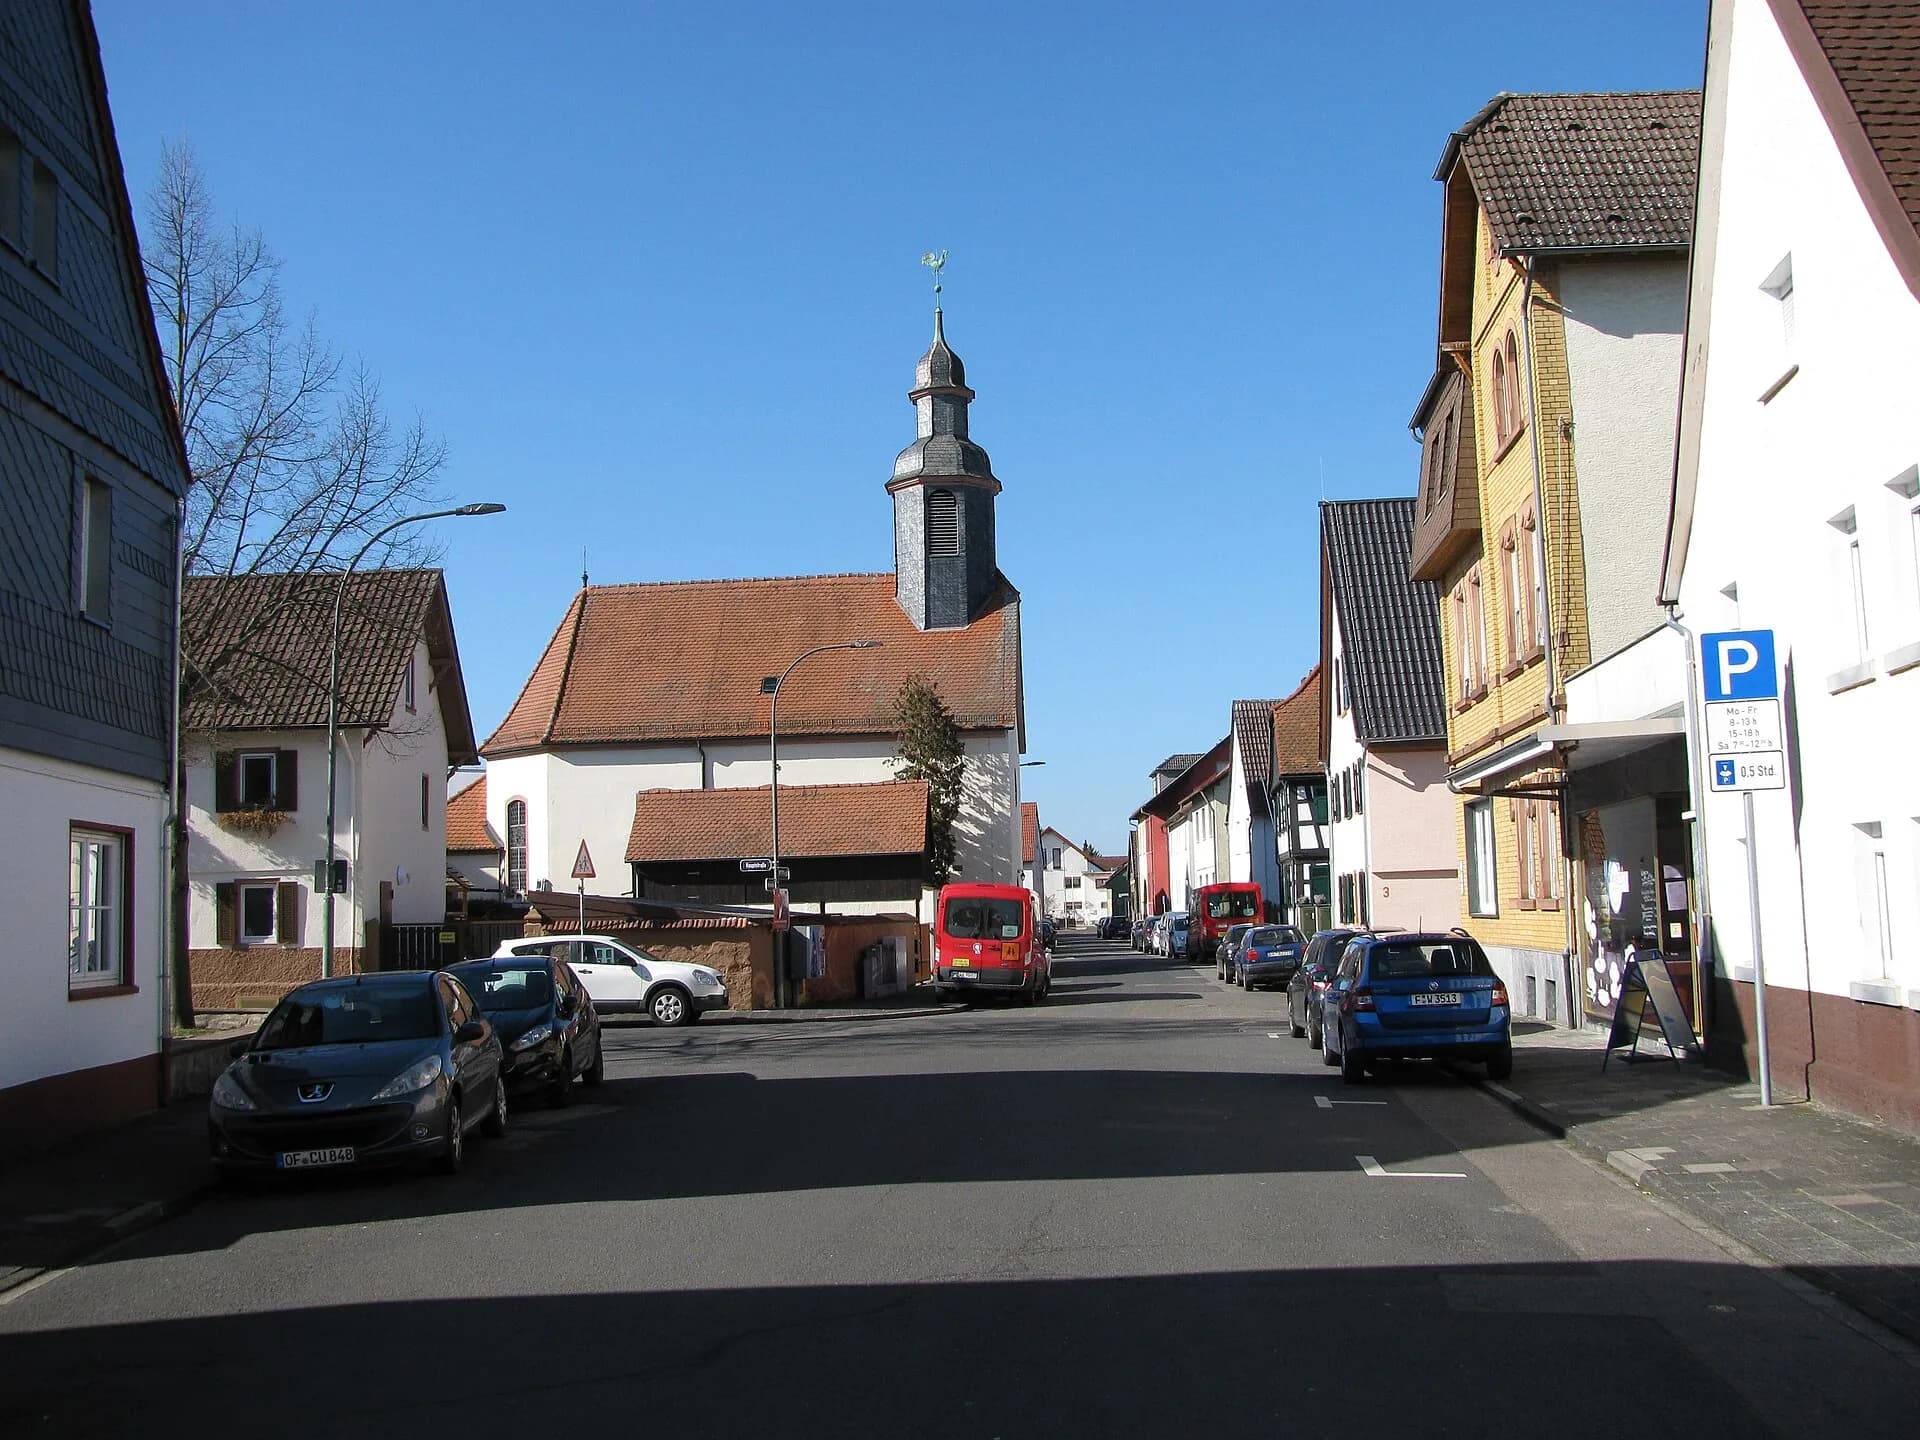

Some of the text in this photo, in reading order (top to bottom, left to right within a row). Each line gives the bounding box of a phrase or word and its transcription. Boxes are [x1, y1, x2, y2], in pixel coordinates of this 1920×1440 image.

[1717, 639, 1759, 696] P
[1717, 741, 1730, 750] Sa
[1382, 886, 1390, 898] 3
[1414, 993, 1457, 1005] F W 3513
[285, 1148, 353, 1166] OF CU 848
